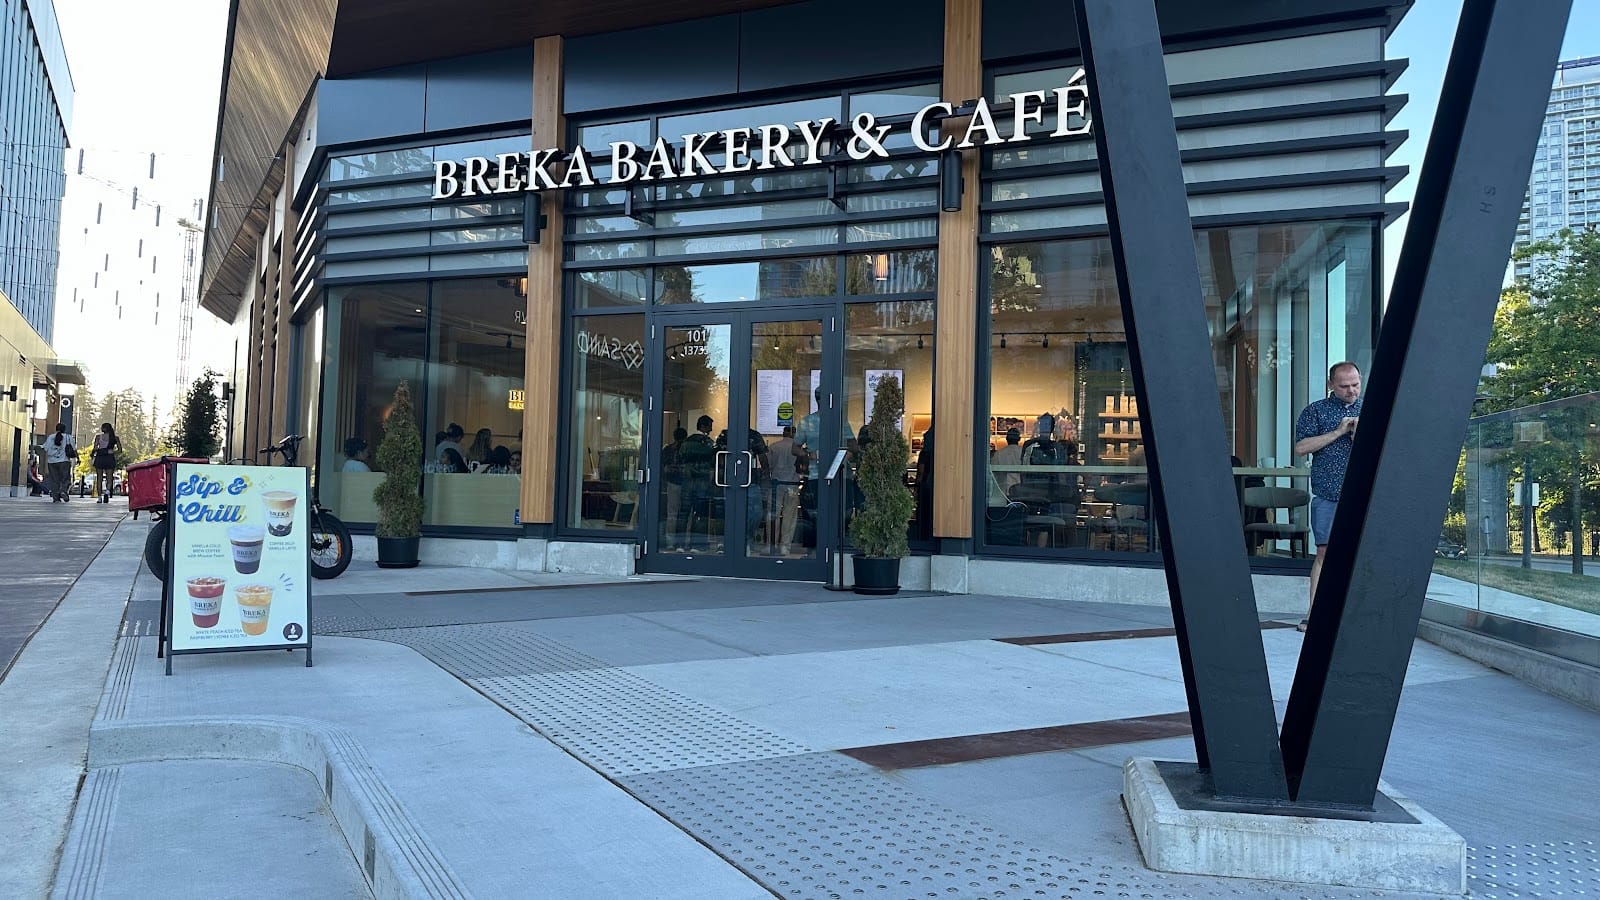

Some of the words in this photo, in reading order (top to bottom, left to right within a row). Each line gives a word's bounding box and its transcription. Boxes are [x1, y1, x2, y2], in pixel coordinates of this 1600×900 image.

[432, 145, 595, 199] BREKA
[608, 117, 835, 184] BAKERY
[847, 112, 891, 160] &
[910, 67, 1093, 152] CAFÉ
[687, 329, 706, 343] 101
[176, 474, 224, 499] Sip
[228, 477, 249, 495] &
[177, 502, 243, 523] Chill
